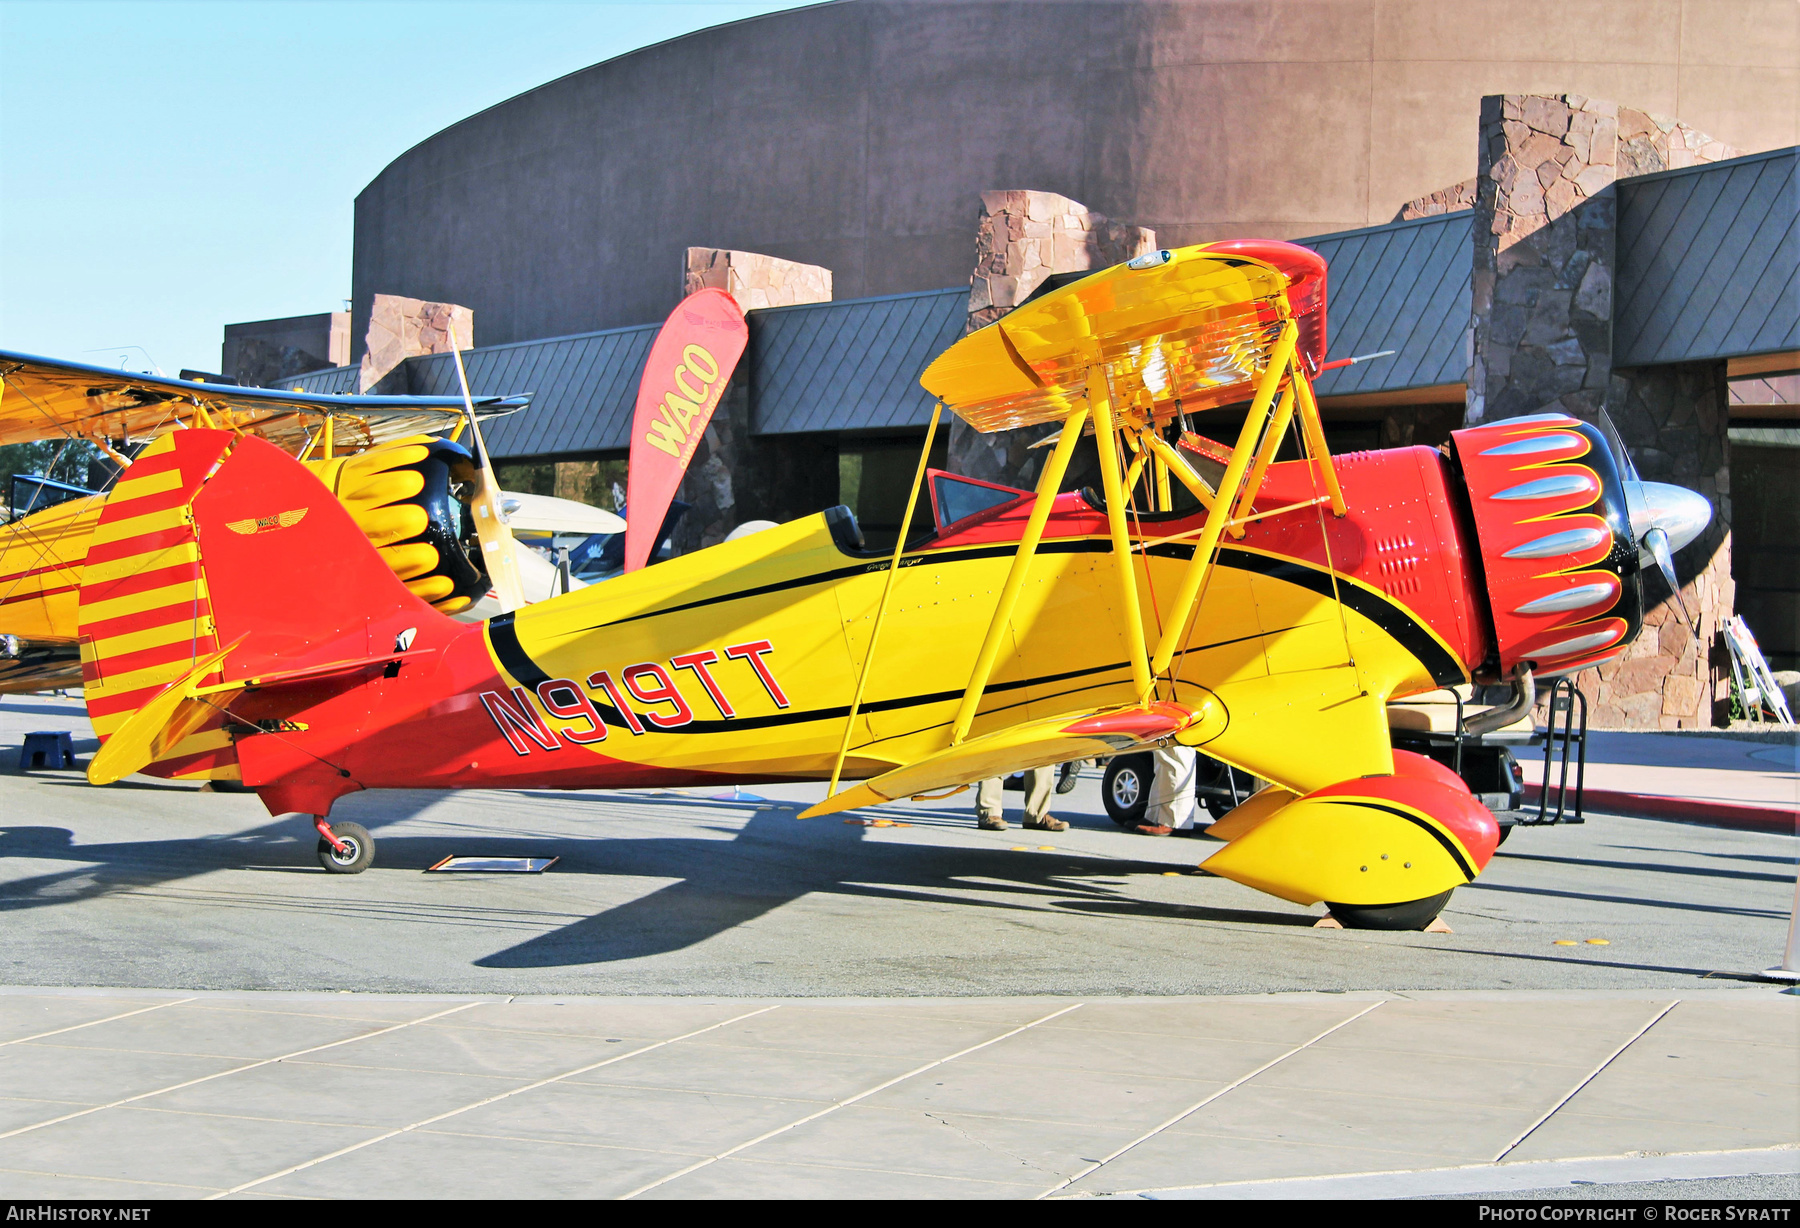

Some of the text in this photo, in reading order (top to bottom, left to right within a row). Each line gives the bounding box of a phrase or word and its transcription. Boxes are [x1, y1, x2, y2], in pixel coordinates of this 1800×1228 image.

[645, 343, 719, 458] WACO
[679, 377, 728, 469] OWN THE DREAM
[256, 515, 279, 527] WACO
[479, 639, 791, 756] N919TT
